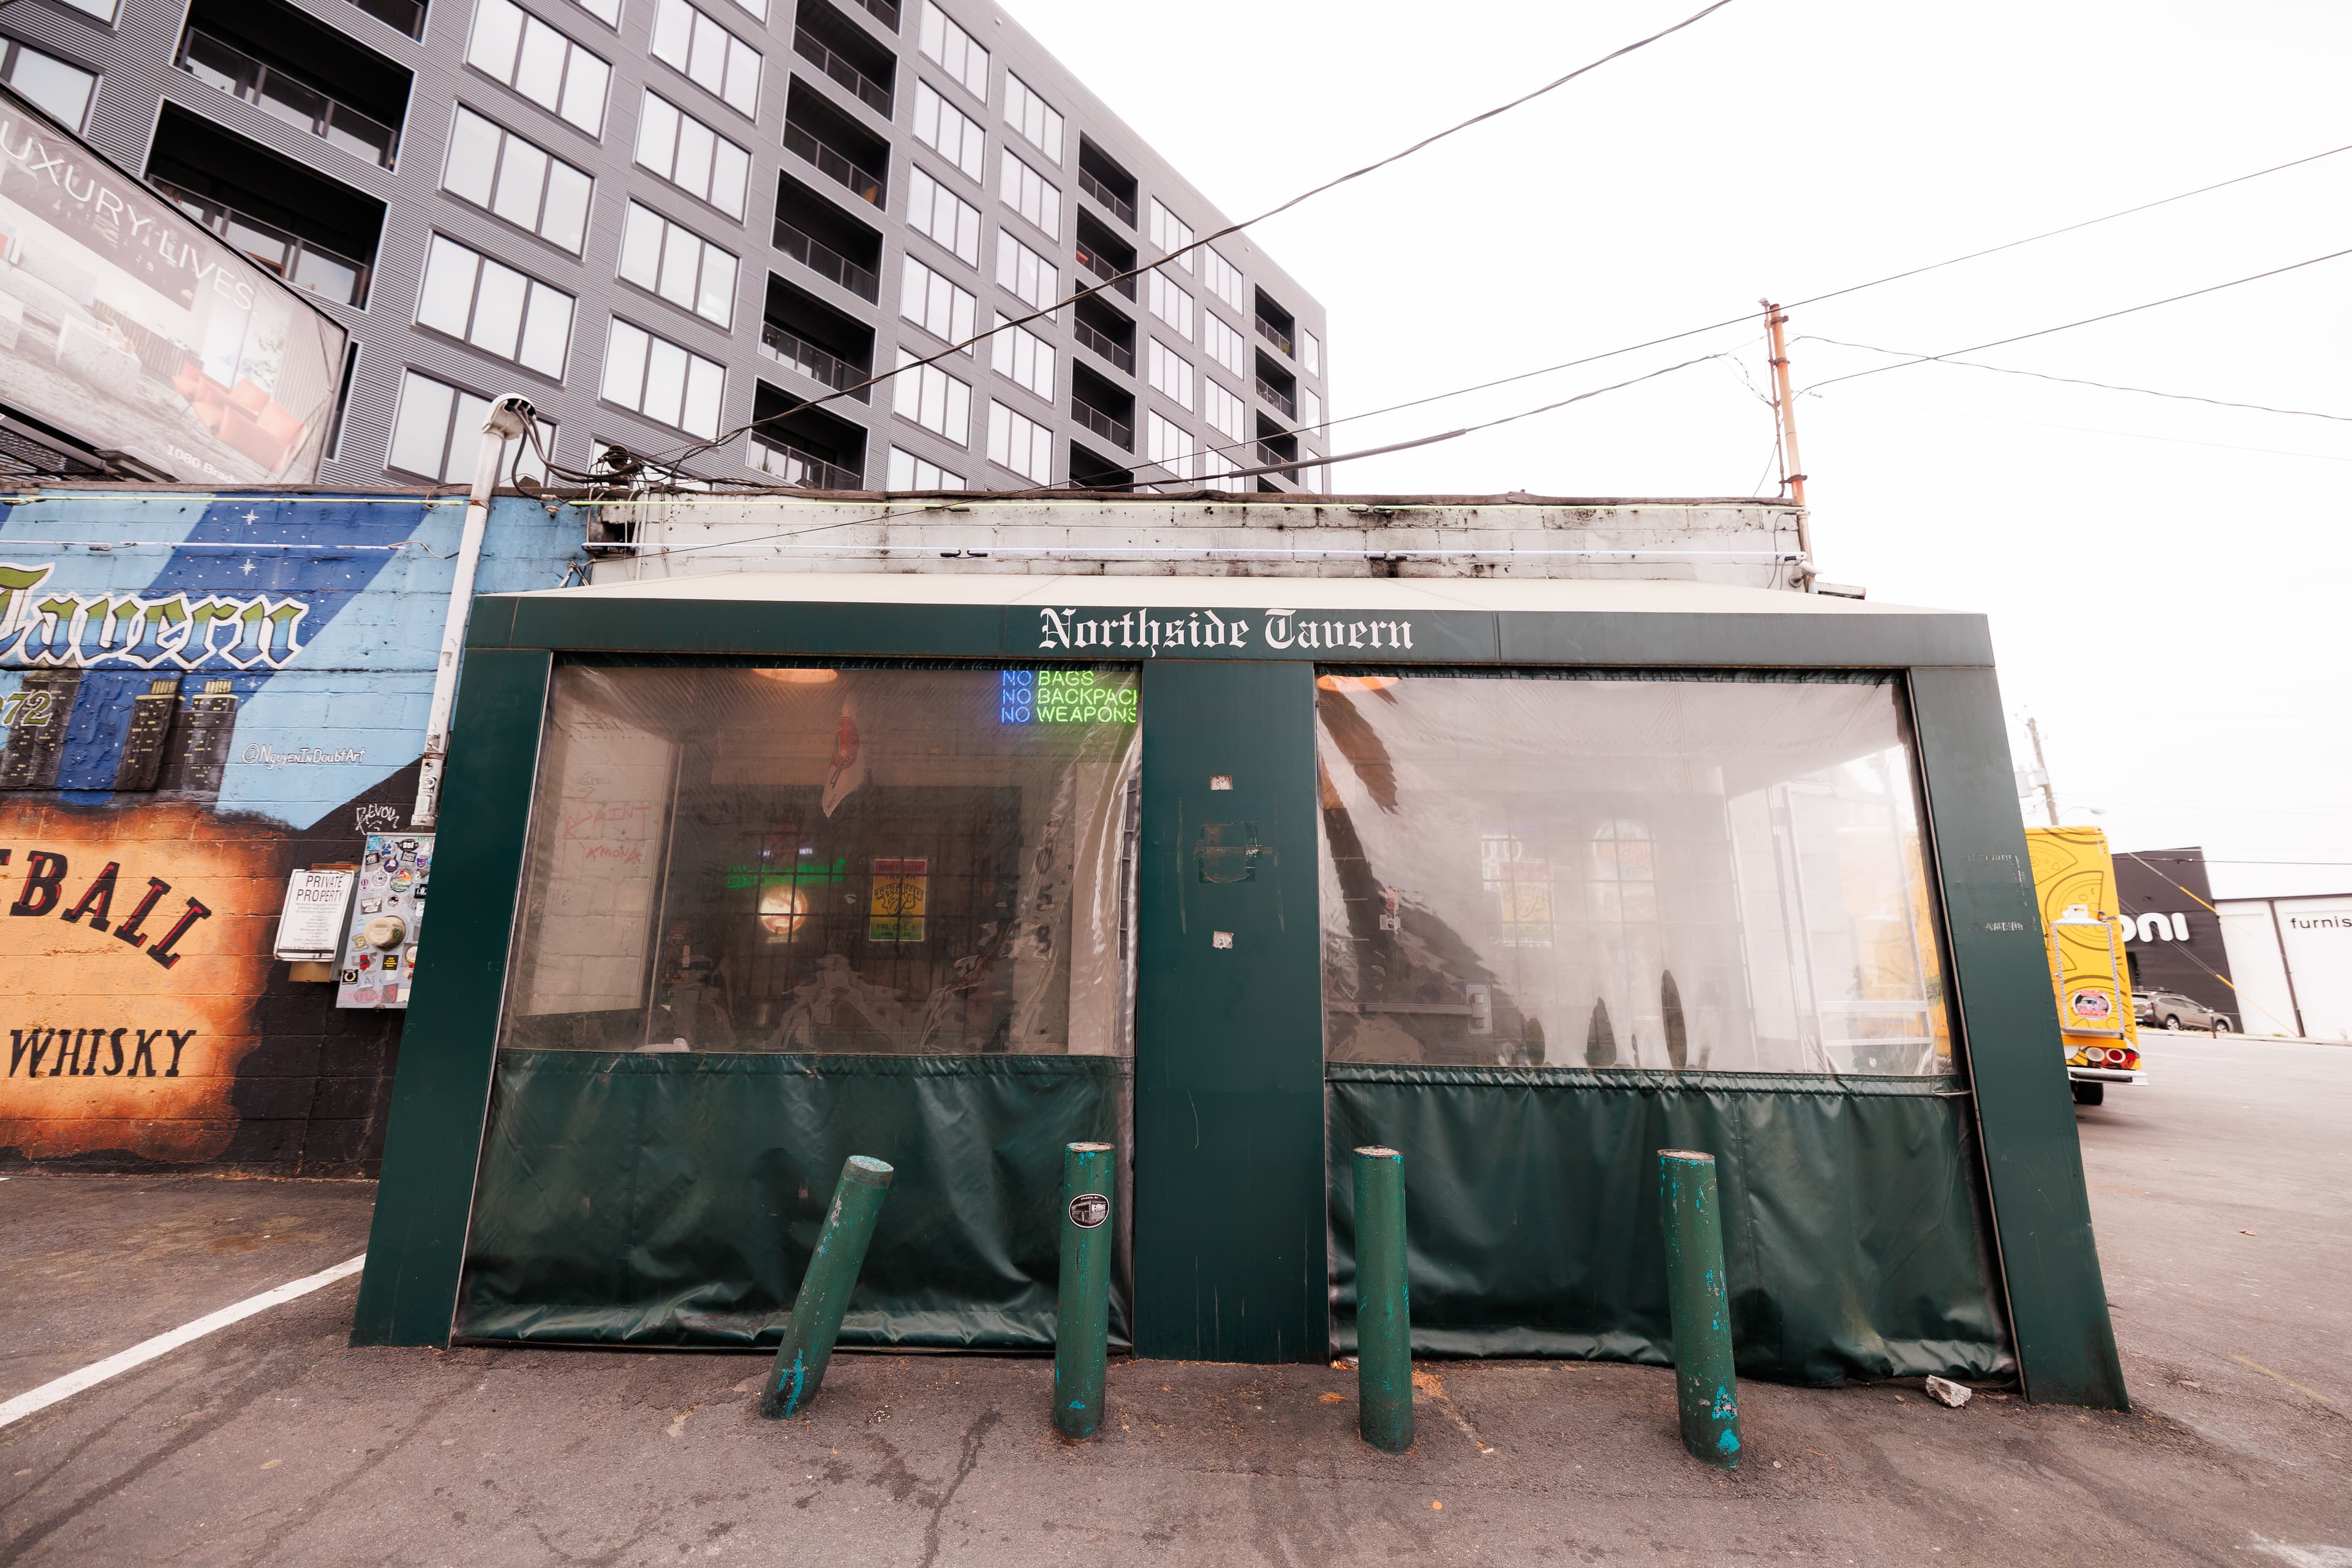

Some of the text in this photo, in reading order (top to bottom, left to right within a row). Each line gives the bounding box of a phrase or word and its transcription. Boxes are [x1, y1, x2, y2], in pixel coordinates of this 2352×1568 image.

[0, 120, 152, 236] UXURY
[167, 445, 240, 484] 1080 Brad
[0, 562, 309, 670] Tavern
[1038, 608, 1415, 658] Northside Tavern
[1002, 669, 1095, 687] NO BAGS
[0, 692, 53, 727] 72
[1002, 688, 1032, 705] NO
[1001, 706, 1137, 723] NO WEAPONS
[878, 864, 922, 872] NORTSIDE
[306, 875, 343, 888] PRIVATE
[296, 889, 344, 902] PROPERTY
[0, 848, 212, 970] BALL
[2290, 918, 2352, 929] furnis
[9, 1027, 197, 1078] WHISKY
